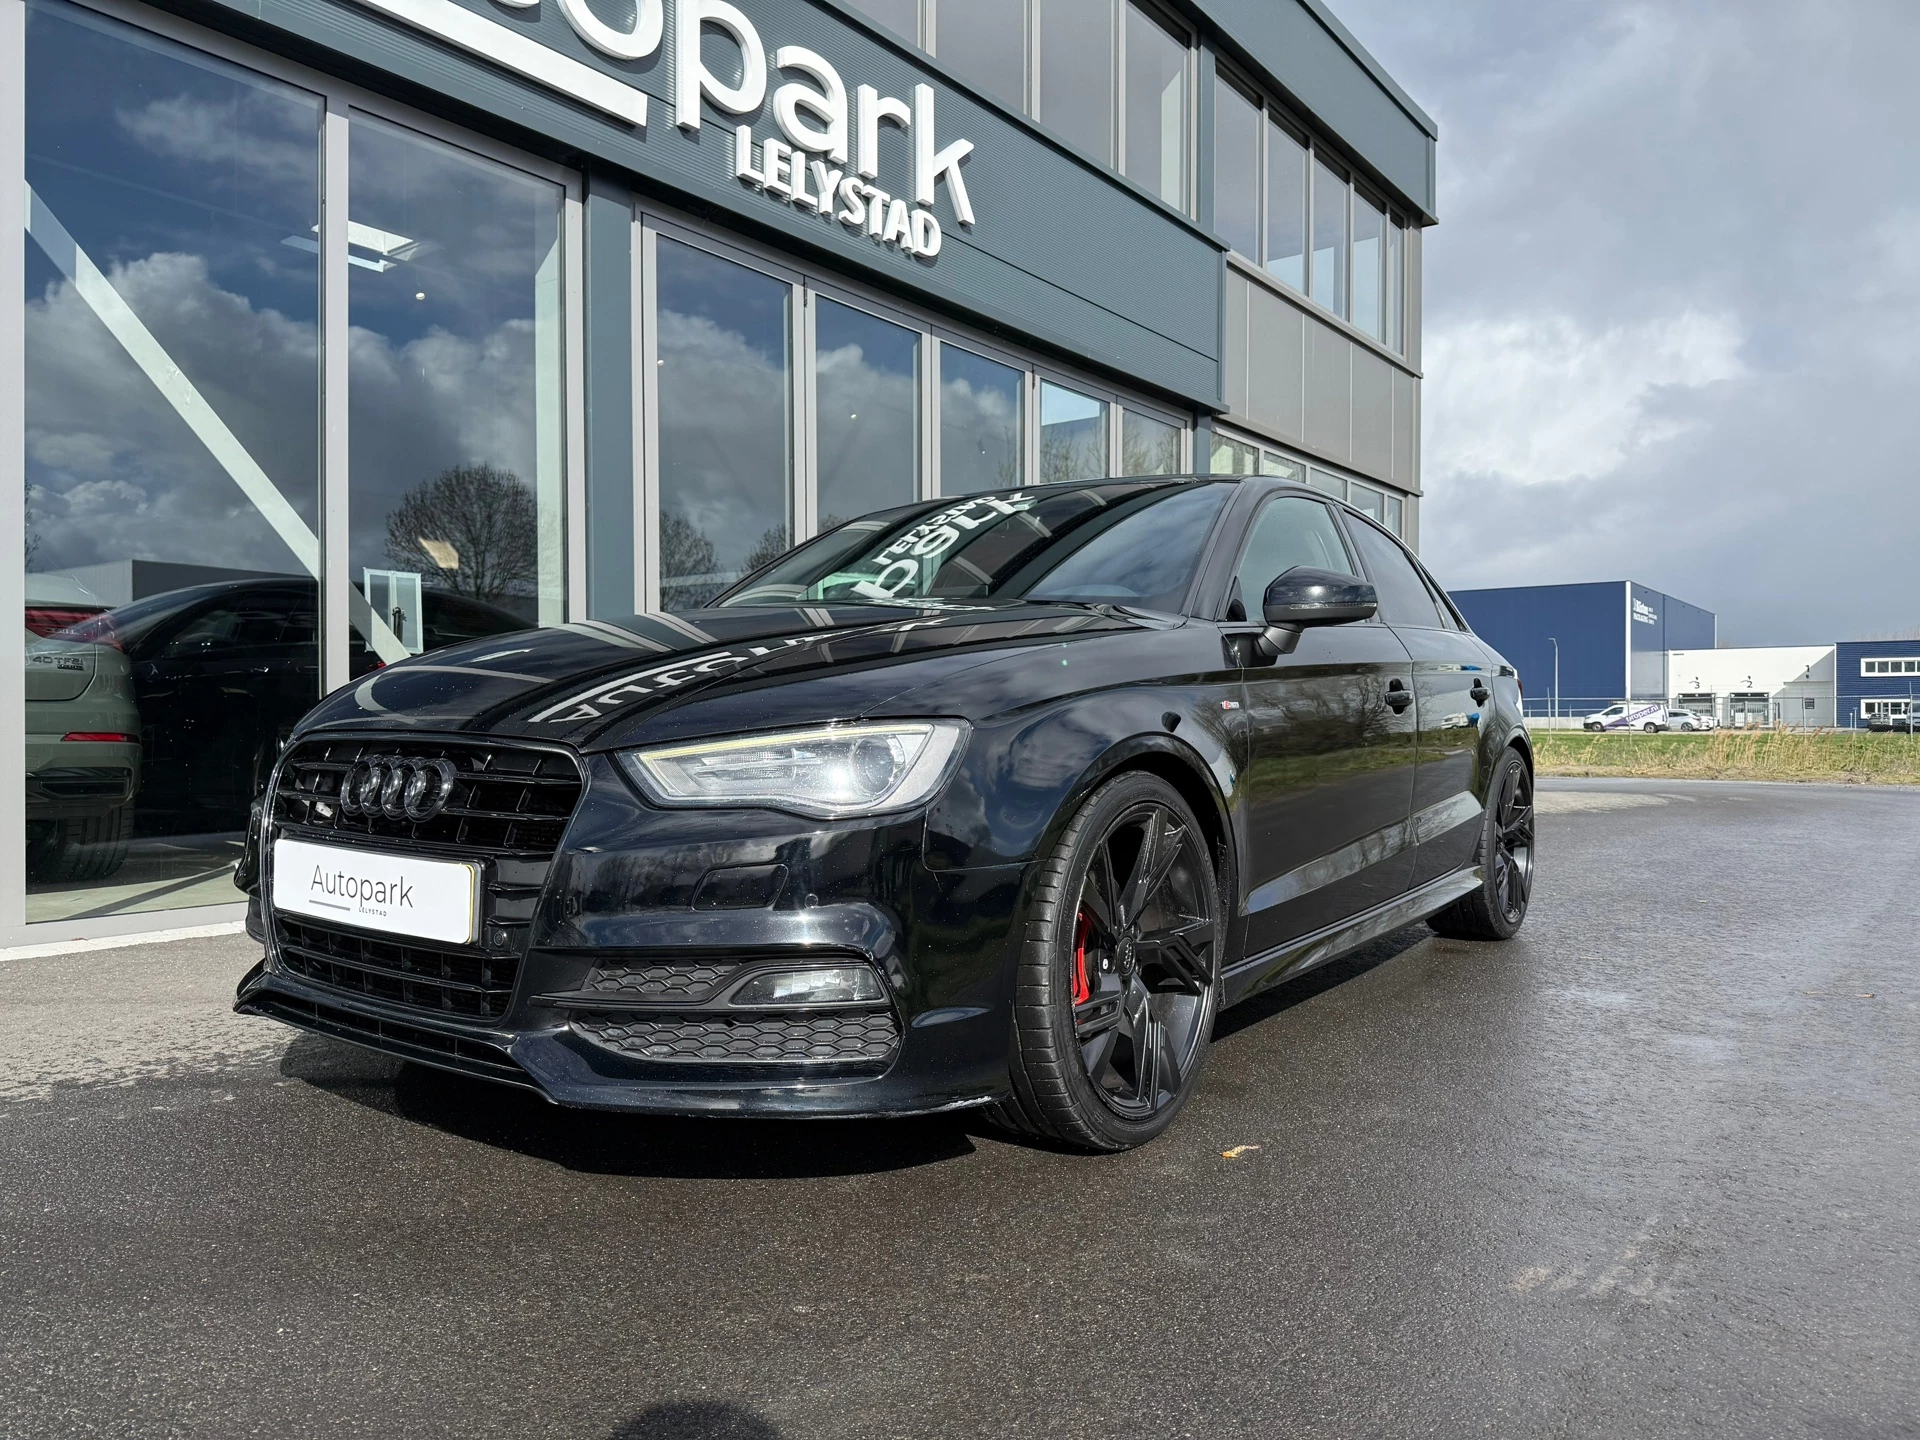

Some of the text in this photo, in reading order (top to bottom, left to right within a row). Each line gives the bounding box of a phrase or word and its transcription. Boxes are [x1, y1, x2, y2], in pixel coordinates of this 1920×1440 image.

[506, 0, 975, 225] opark
[736, 125, 942, 258] LELYSTAD
[310, 864, 413, 907] Autopark
[358, 906, 387, 917] LELYSTAD
